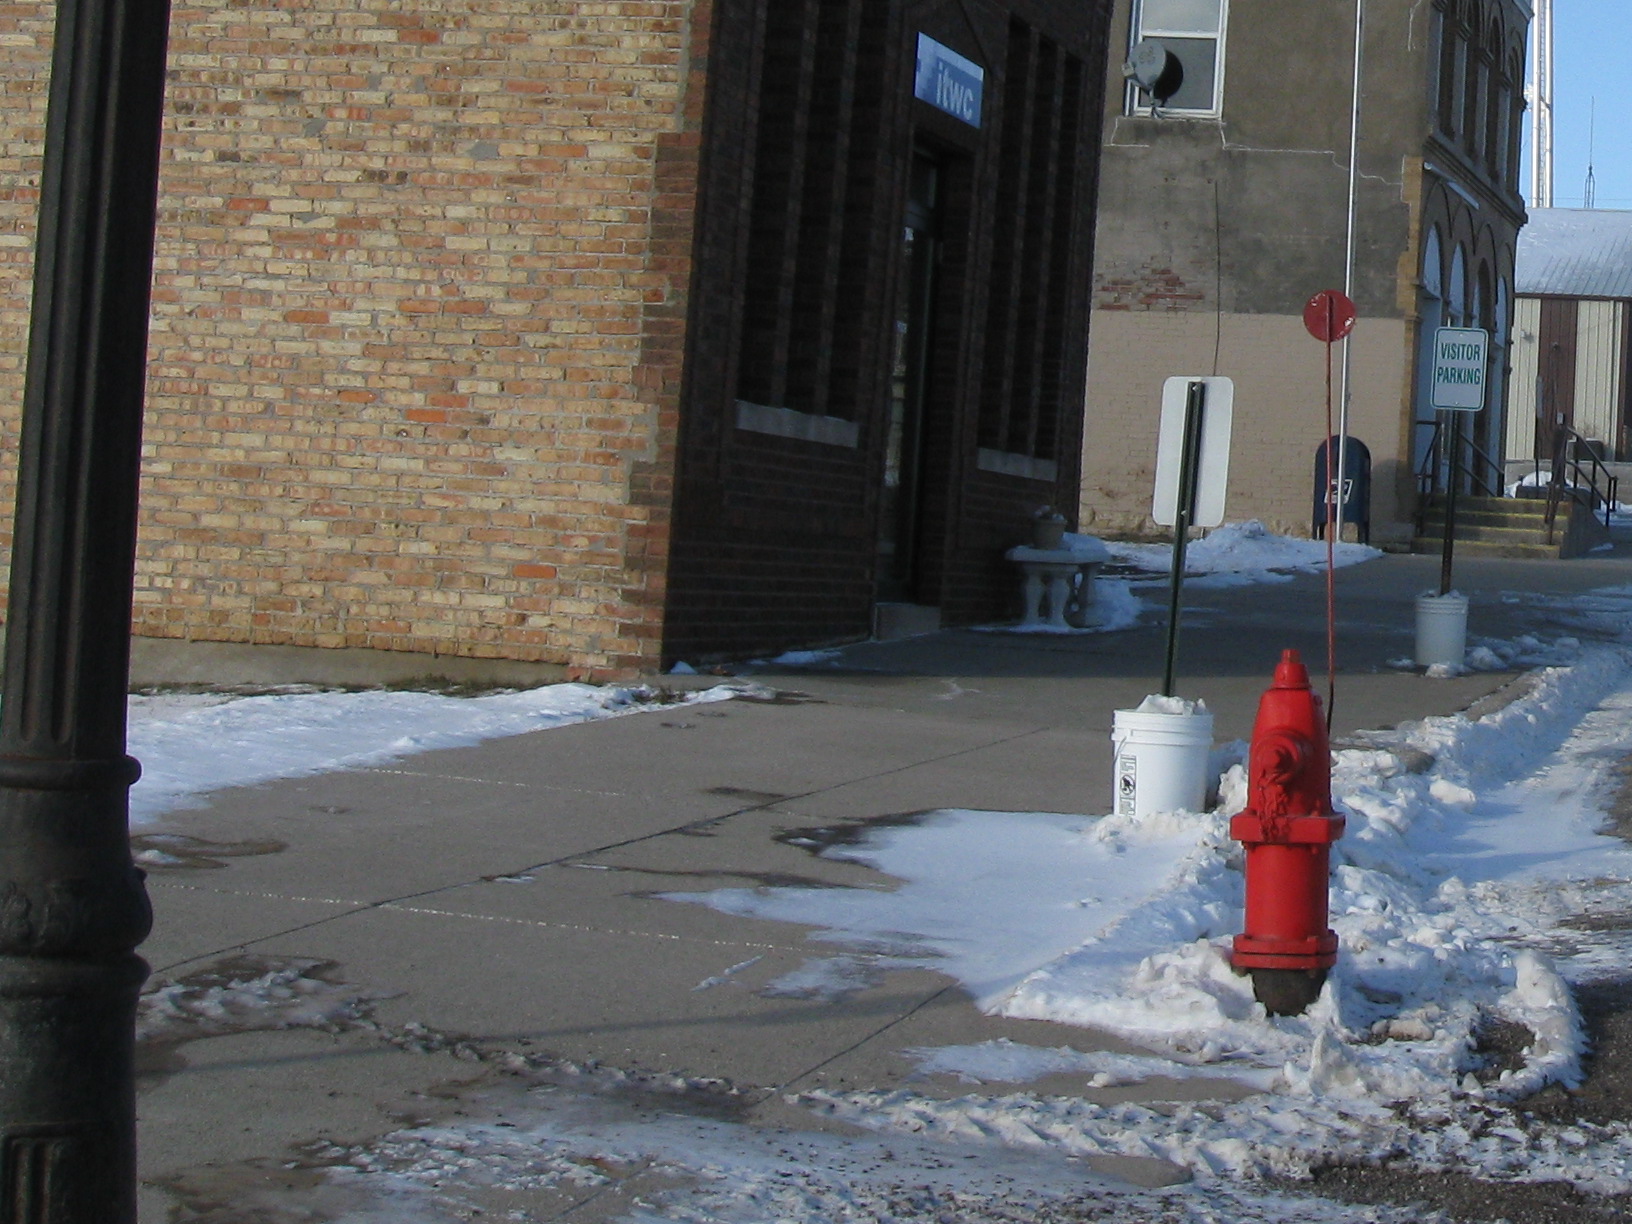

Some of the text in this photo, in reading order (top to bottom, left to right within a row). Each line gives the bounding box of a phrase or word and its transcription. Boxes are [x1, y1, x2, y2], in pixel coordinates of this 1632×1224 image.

[935, 61, 974, 121] itwc
[1440, 342, 1481, 361] VISITOR
[1436, 366, 1482, 385] PARKING
